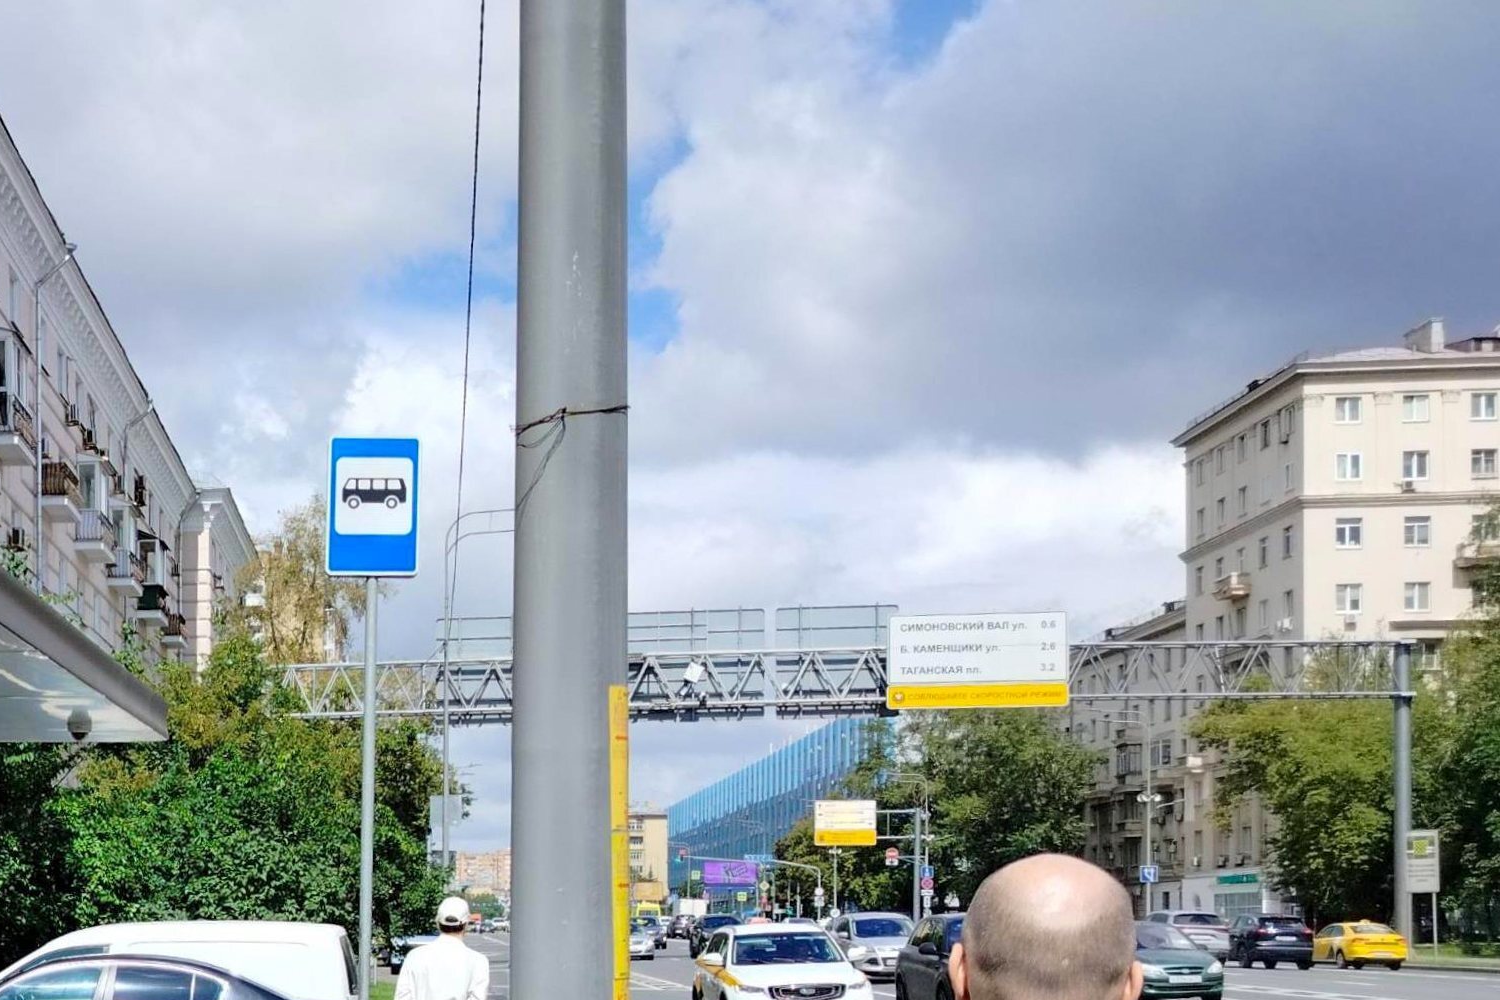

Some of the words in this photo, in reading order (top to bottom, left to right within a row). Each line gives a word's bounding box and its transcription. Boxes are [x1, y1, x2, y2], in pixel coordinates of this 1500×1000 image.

[900, 620, 984, 632] СИМОНОВСКИЙ
[987, 620, 1010, 630] ВАЛ
[1012, 622, 1028, 632] ул.
[913, 644, 983, 654] КАМЕНЩИКИ
[985, 645, 1001, 655] ул.
[900, 665, 963, 675] ТАГАНСКАЯ
[966, 667, 982, 675] пл.
